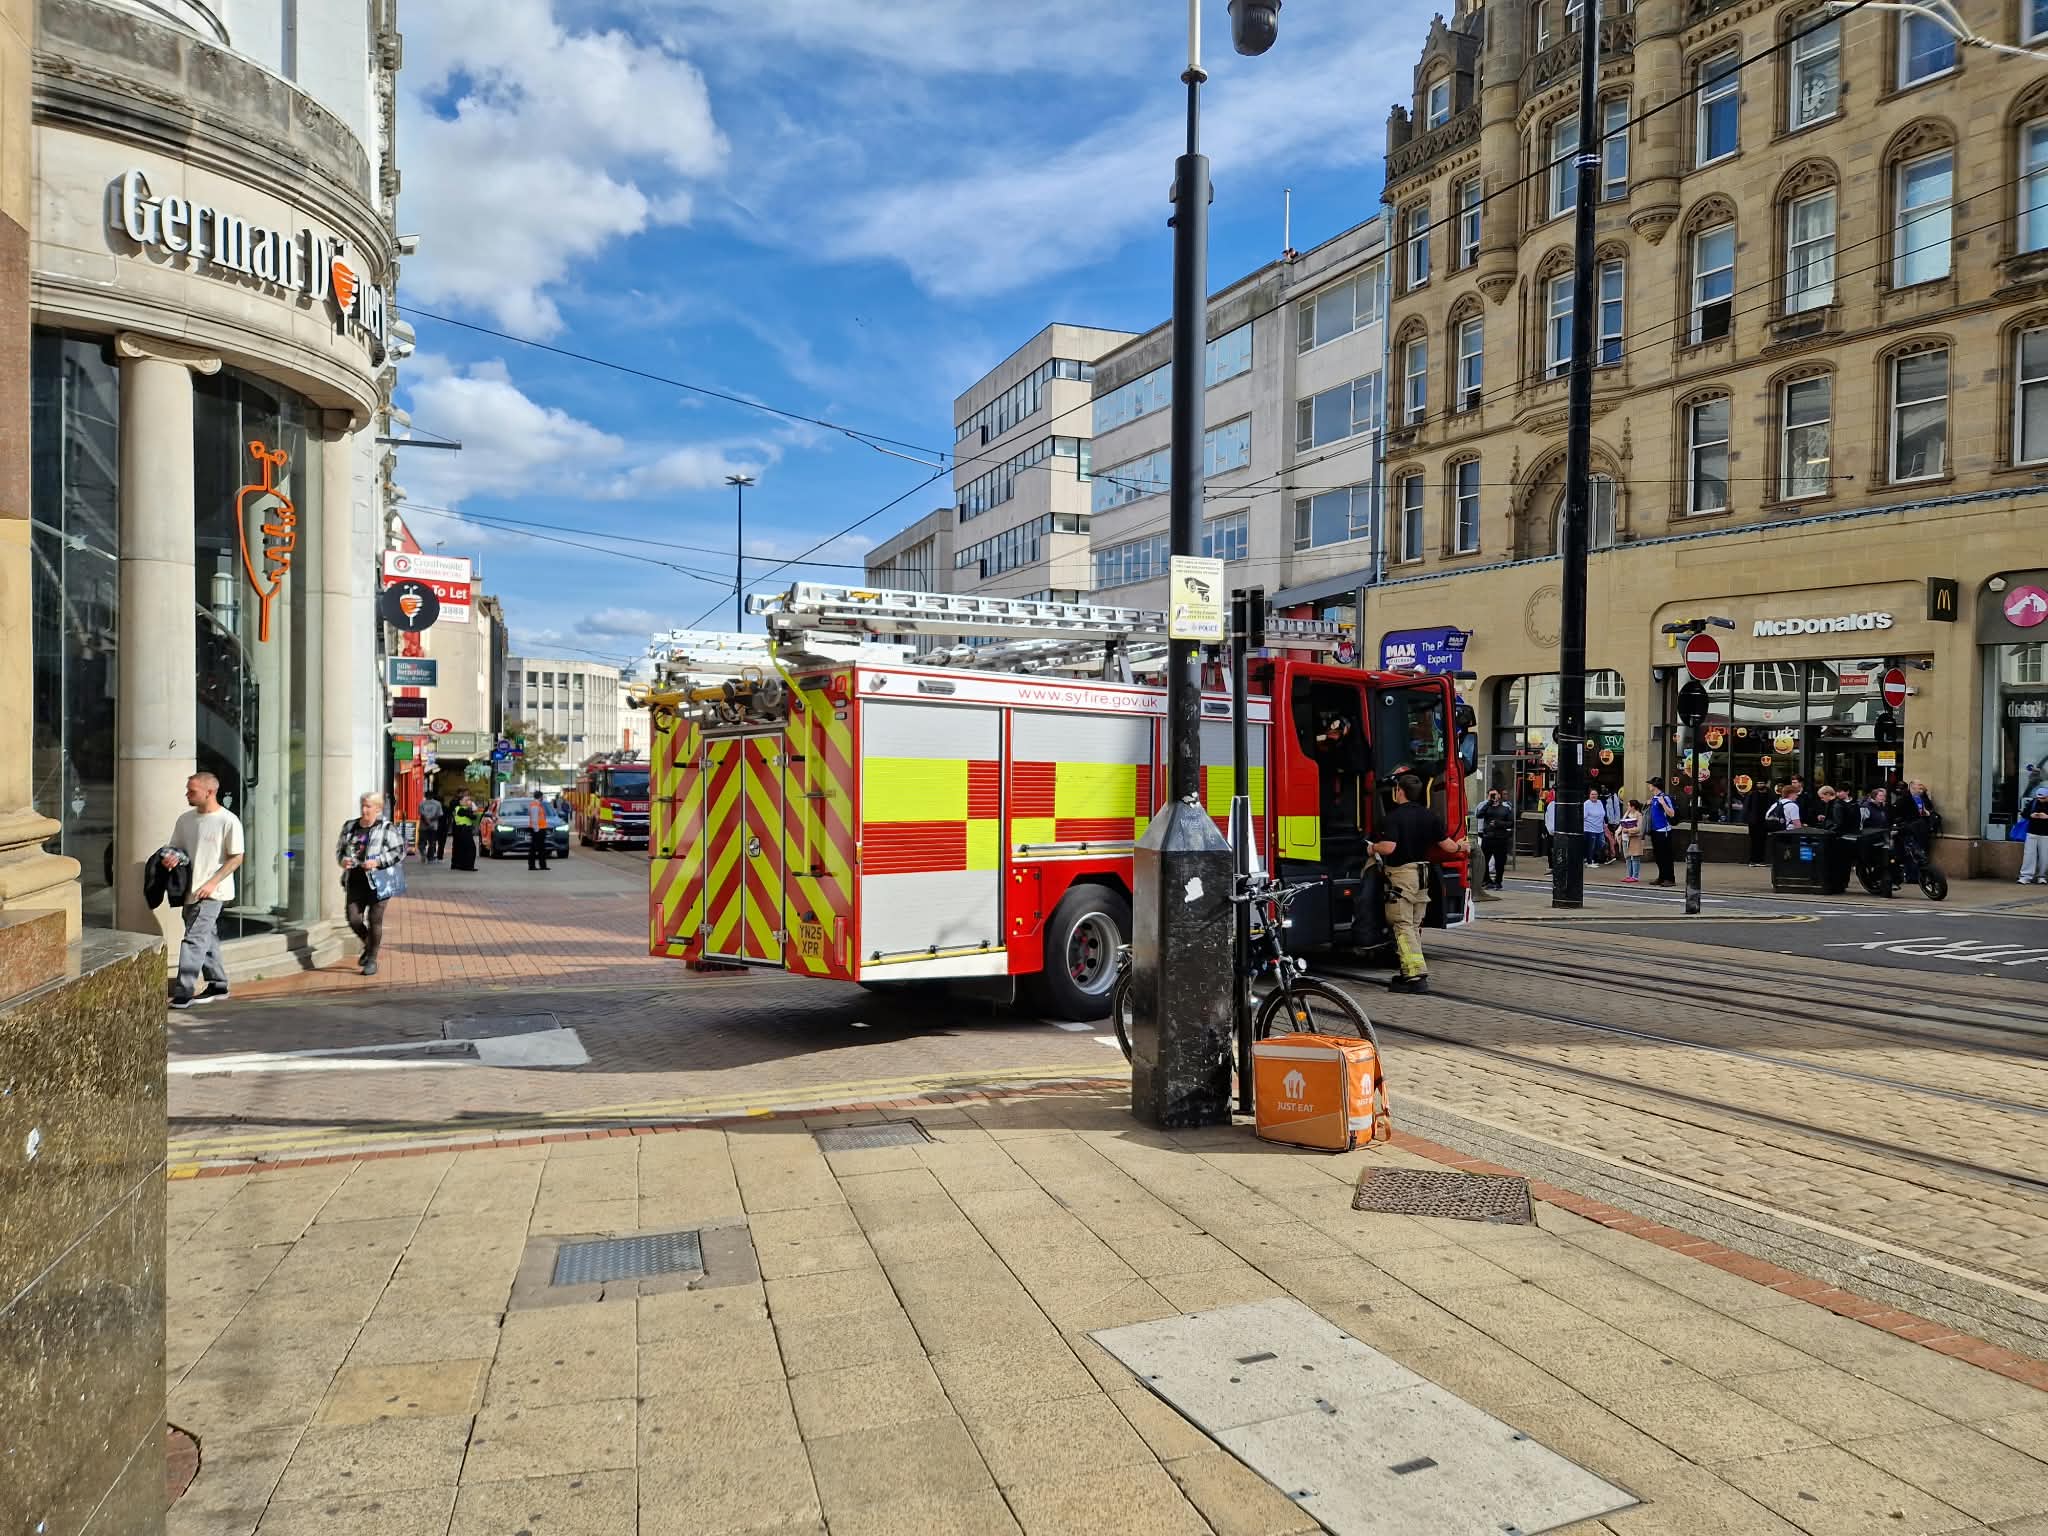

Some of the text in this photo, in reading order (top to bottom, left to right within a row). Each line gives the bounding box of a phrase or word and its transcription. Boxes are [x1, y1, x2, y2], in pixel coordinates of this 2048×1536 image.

[123, 168, 303, 291] German
[432, 585, 468, 599] To Let
[1752, 611, 1894, 637] McDonald's
[1386, 643, 1416, 658] MAX
[1422, 641, 1435, 652] The
[1427, 654, 1453, 665] Expert
[1018, 687, 1159, 709] www.syfire.gov.uk
[632, 802, 649, 812] FIRE
[800, 924, 822, 940] YN25
[802, 940, 819, 956] XPR
[1277, 1102, 1313, 1113] JUST EAT
